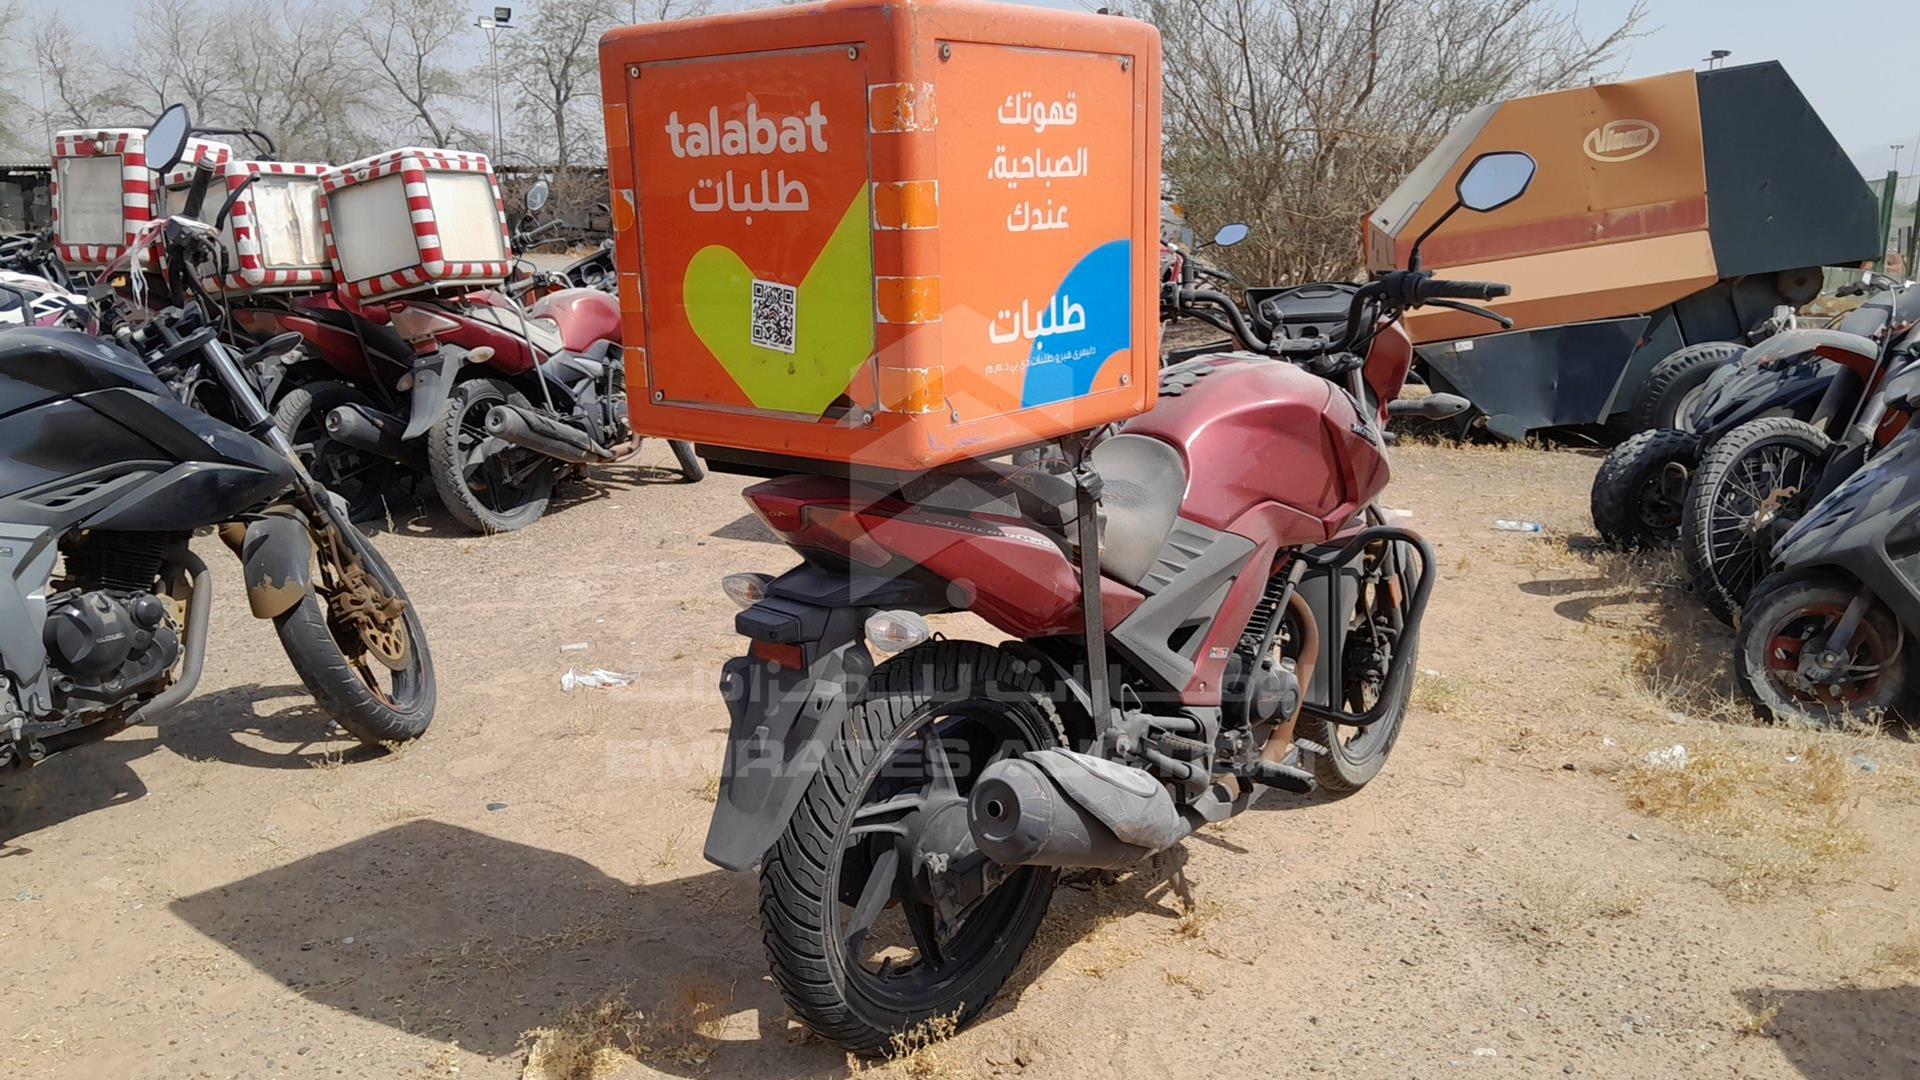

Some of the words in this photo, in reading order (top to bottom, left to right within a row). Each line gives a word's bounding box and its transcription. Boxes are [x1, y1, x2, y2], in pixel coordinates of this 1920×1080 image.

[664, 100, 829, 159] talabat
[997, 91, 1078, 133] قهوتك
[987, 144, 1088, 189] الصباحية،
[688, 168, 810, 226] طلبات
[1006, 198, 1070, 232] عندك
[988, 294, 1086, 351] طلبات
